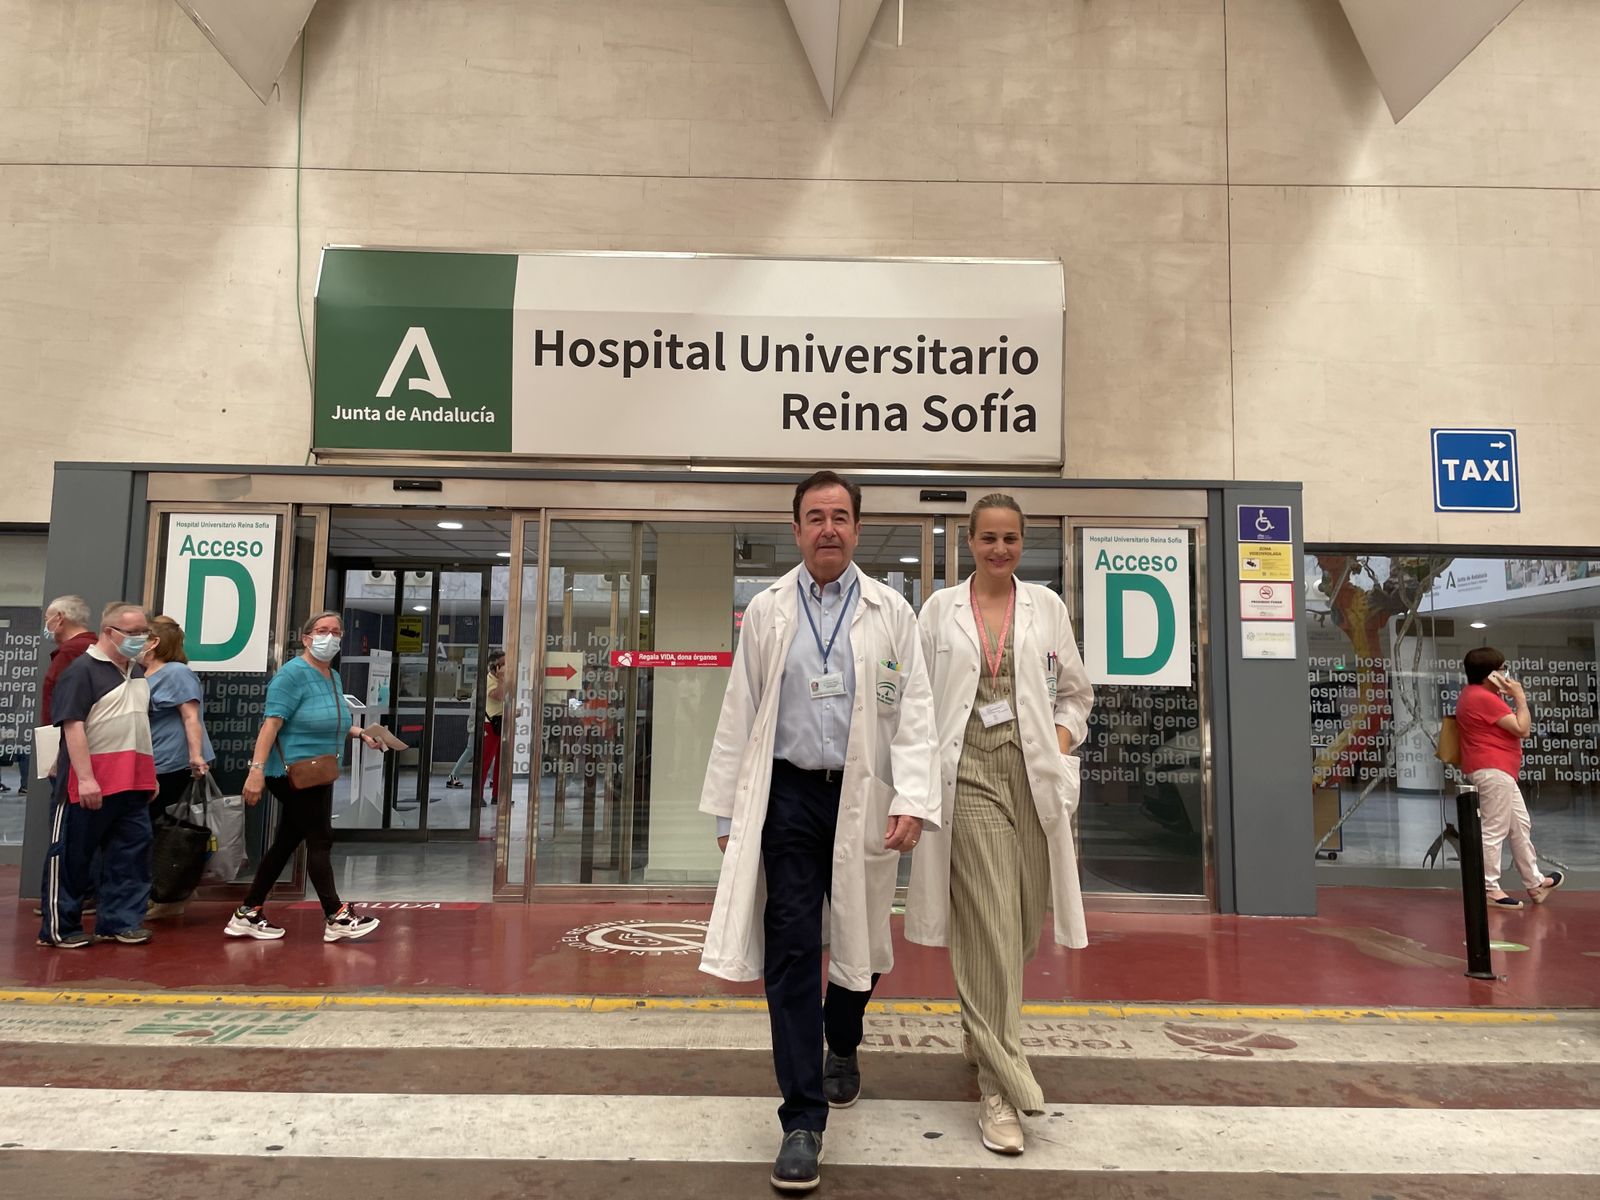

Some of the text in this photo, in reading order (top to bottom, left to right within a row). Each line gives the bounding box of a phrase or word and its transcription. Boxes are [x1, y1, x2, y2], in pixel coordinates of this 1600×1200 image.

[534, 329, 1039, 378] Hospital Universitario
[331, 405, 496, 424] Junta de Andalucía
[782, 388, 1037, 433] Reina Sofía
[1441, 458, 1510, 482] TAXI
[176, 521, 200, 529] Hospital
[201, 521, 237, 529] Universitario
[179, 534, 264, 557] Acceso
[1095, 549, 1178, 572] Acceso
[185, 558, 257, 662] D
[1105, 572, 1176, 676] D
[638, 653, 660, 661] Regala
[693, 653, 718, 661] órganos
[1329, 669, 1389, 686] hospital
[1522, 673, 1578, 688] general
[1088, 711, 1147, 728] ospital
[1535, 704, 1594, 721] hospital
[542, 721, 606, 739] general
[1314, 717, 1371, 732] general
[1097, 731, 1165, 748] general
[1542, 736, 1598, 752] general
[1118, 748, 1190, 768] hospital
[1321, 749, 1382, 764] hospital
[1080, 766, 1140, 784] ospital
[350, 902, 441, 910] ALIDA
[1027, 1023, 1117, 1035] don
[863, 1033, 1134, 1050] rega VID
